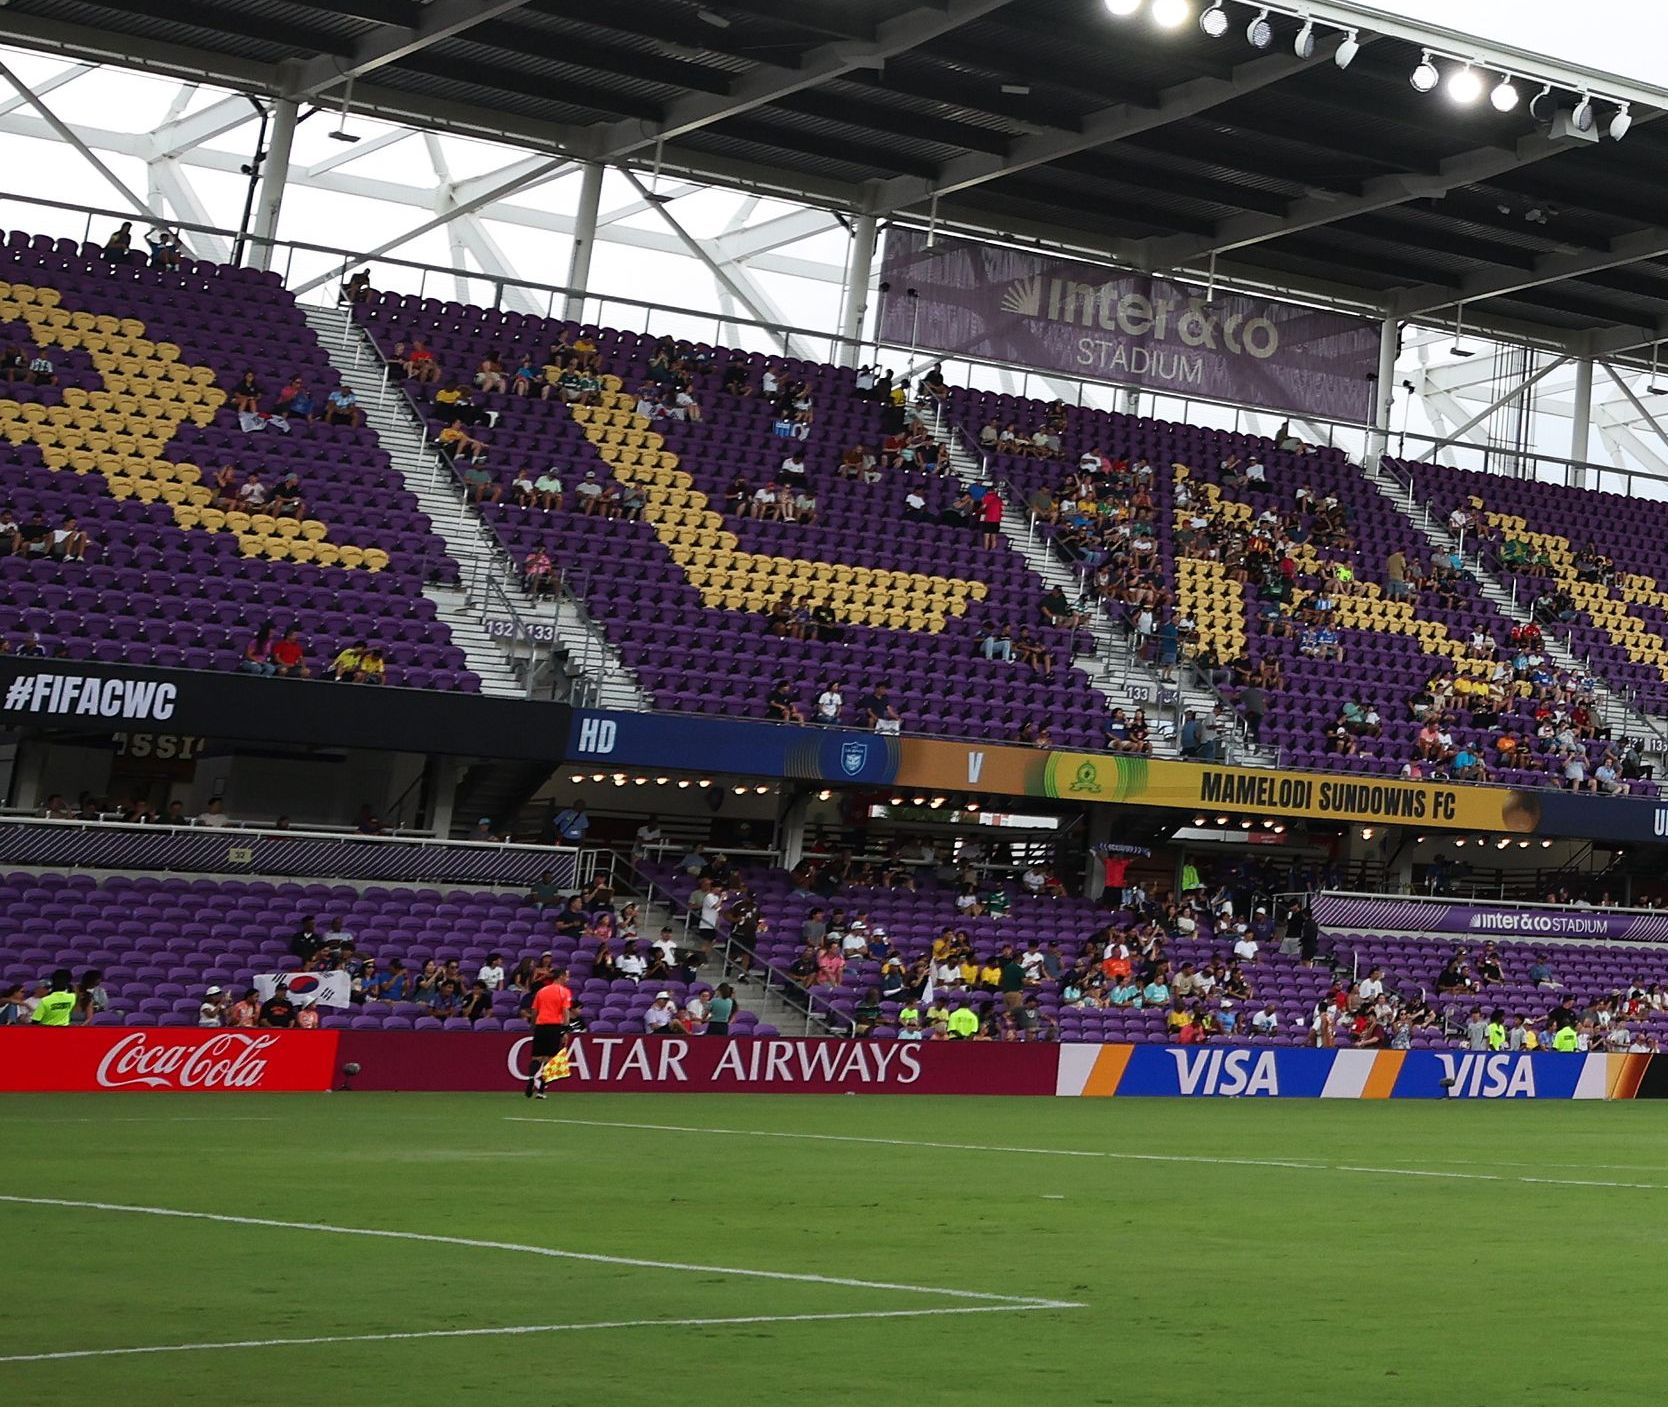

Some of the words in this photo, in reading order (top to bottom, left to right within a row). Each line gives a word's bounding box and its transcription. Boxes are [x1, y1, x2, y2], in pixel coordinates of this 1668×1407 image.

[1077, 338, 1203, 384] STADIUM
[486, 621, 514, 637] 132
[526, 624, 554, 641] 133
[4, 673, 177, 721] #FIFACWC
[1127, 686, 1148, 701] 133
[578, 718, 617, 754] HD
[966, 751, 984, 784] V
[1200, 771, 1313, 810] MAMELODI
[1318, 782, 1427, 816] SUNDOWNS
[1433, 790, 1456, 820] FC
[1552, 917, 1608, 934] STADIUM
[96, 1032, 280, 1087] Coca-Cola
[711, 1039, 922, 1084] AIRWAYS
[1165, 1049, 1279, 1096] VISA
[1434, 1054, 1537, 1098] VISA
